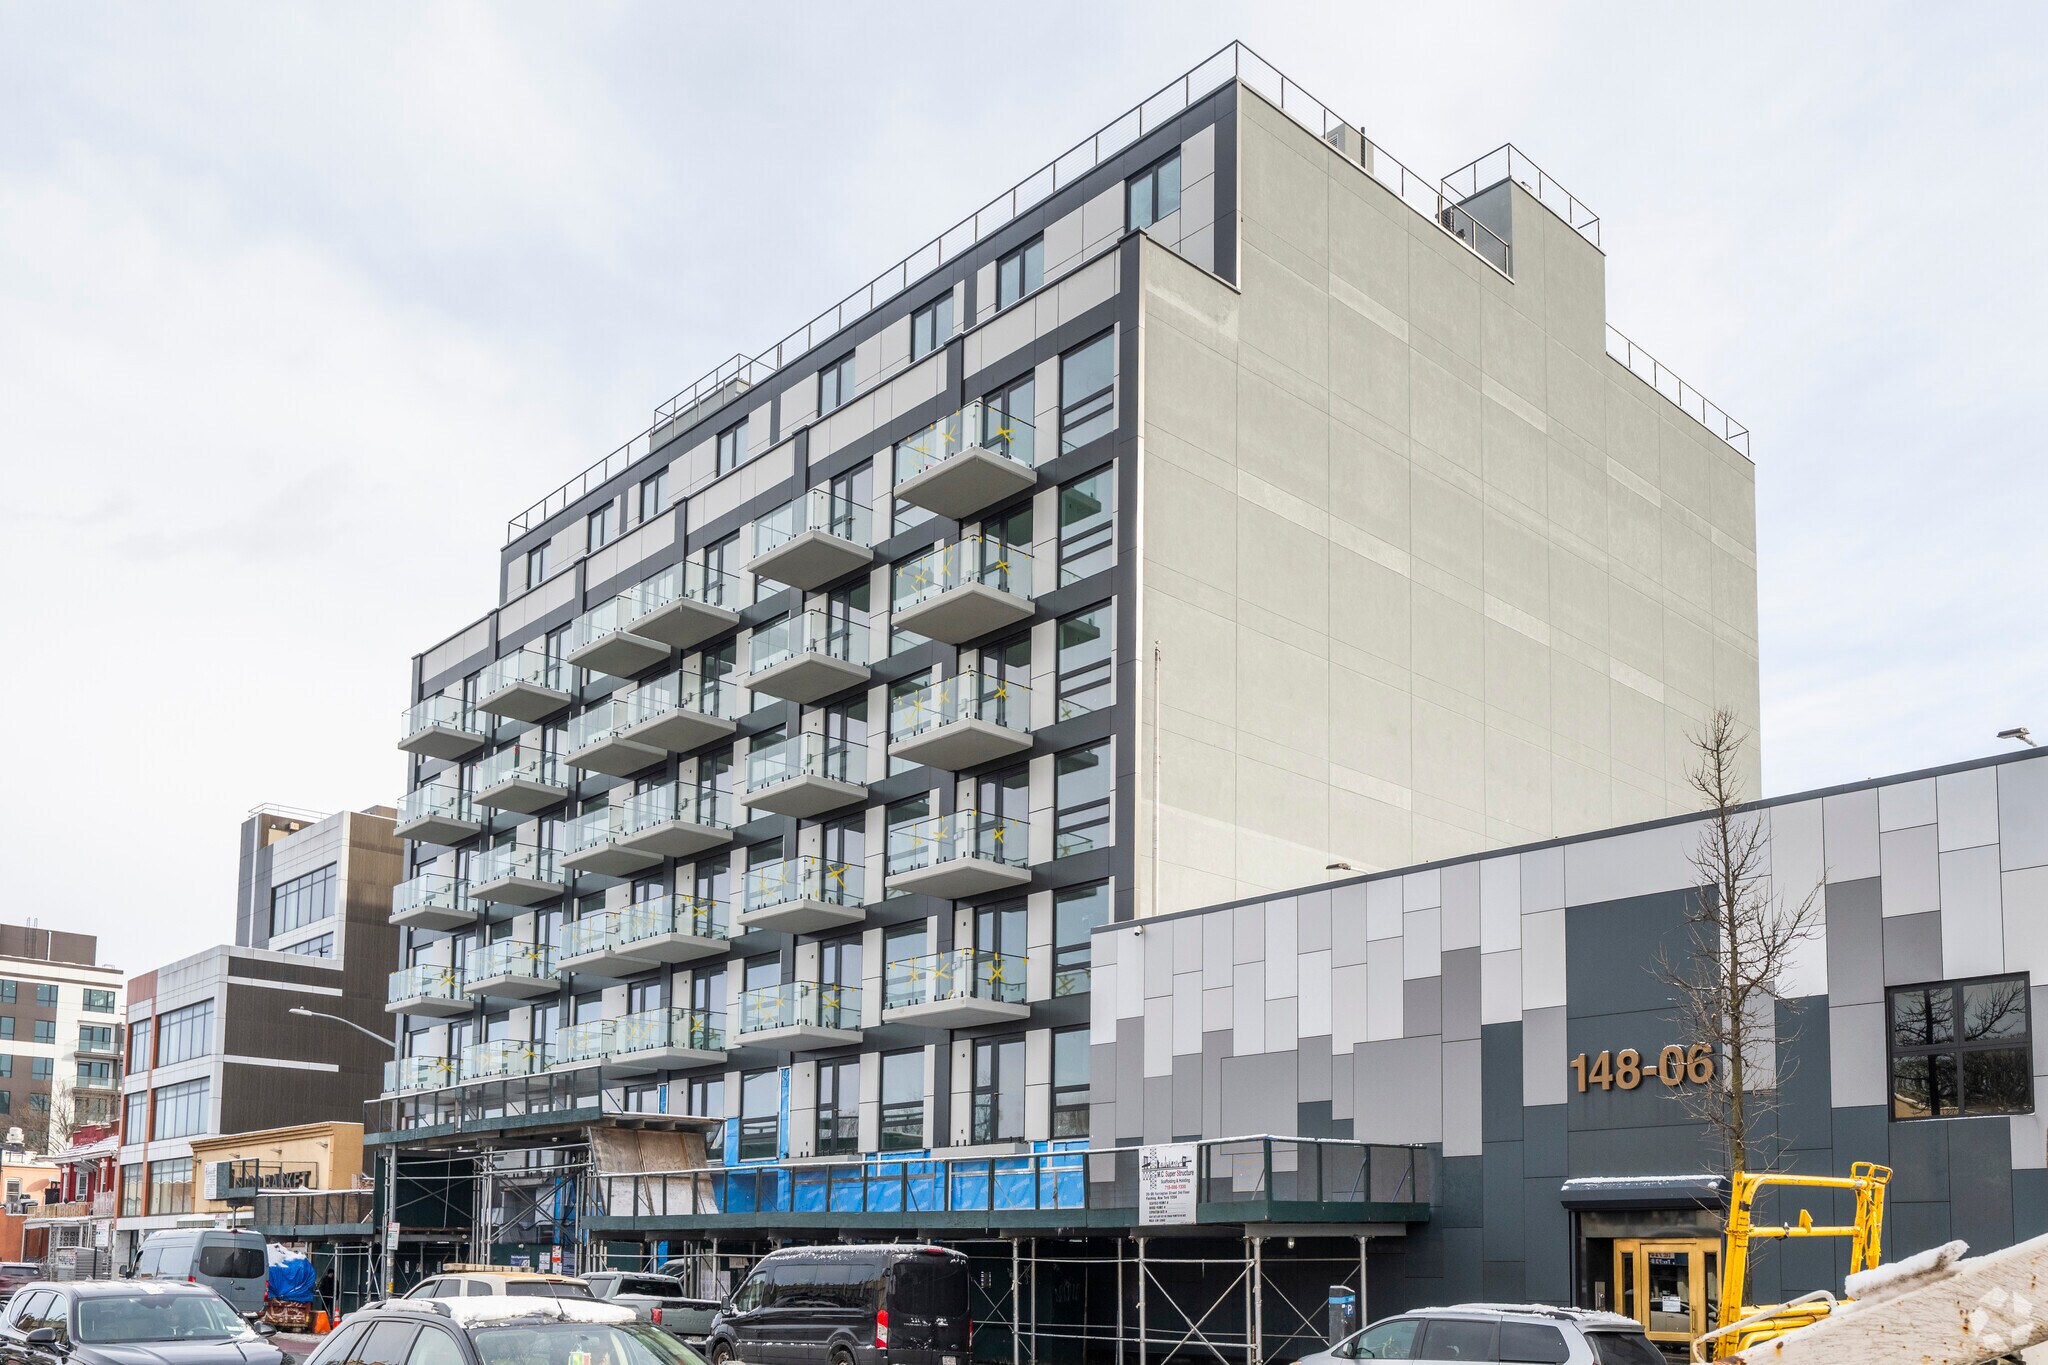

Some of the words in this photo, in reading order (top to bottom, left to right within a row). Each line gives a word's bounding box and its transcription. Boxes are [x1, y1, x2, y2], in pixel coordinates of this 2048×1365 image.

[1570, 1041, 1714, 1092] 148-06
[1164, 1170, 1176, 1178] Super
[1176, 1169, 1194, 1177] Structure
